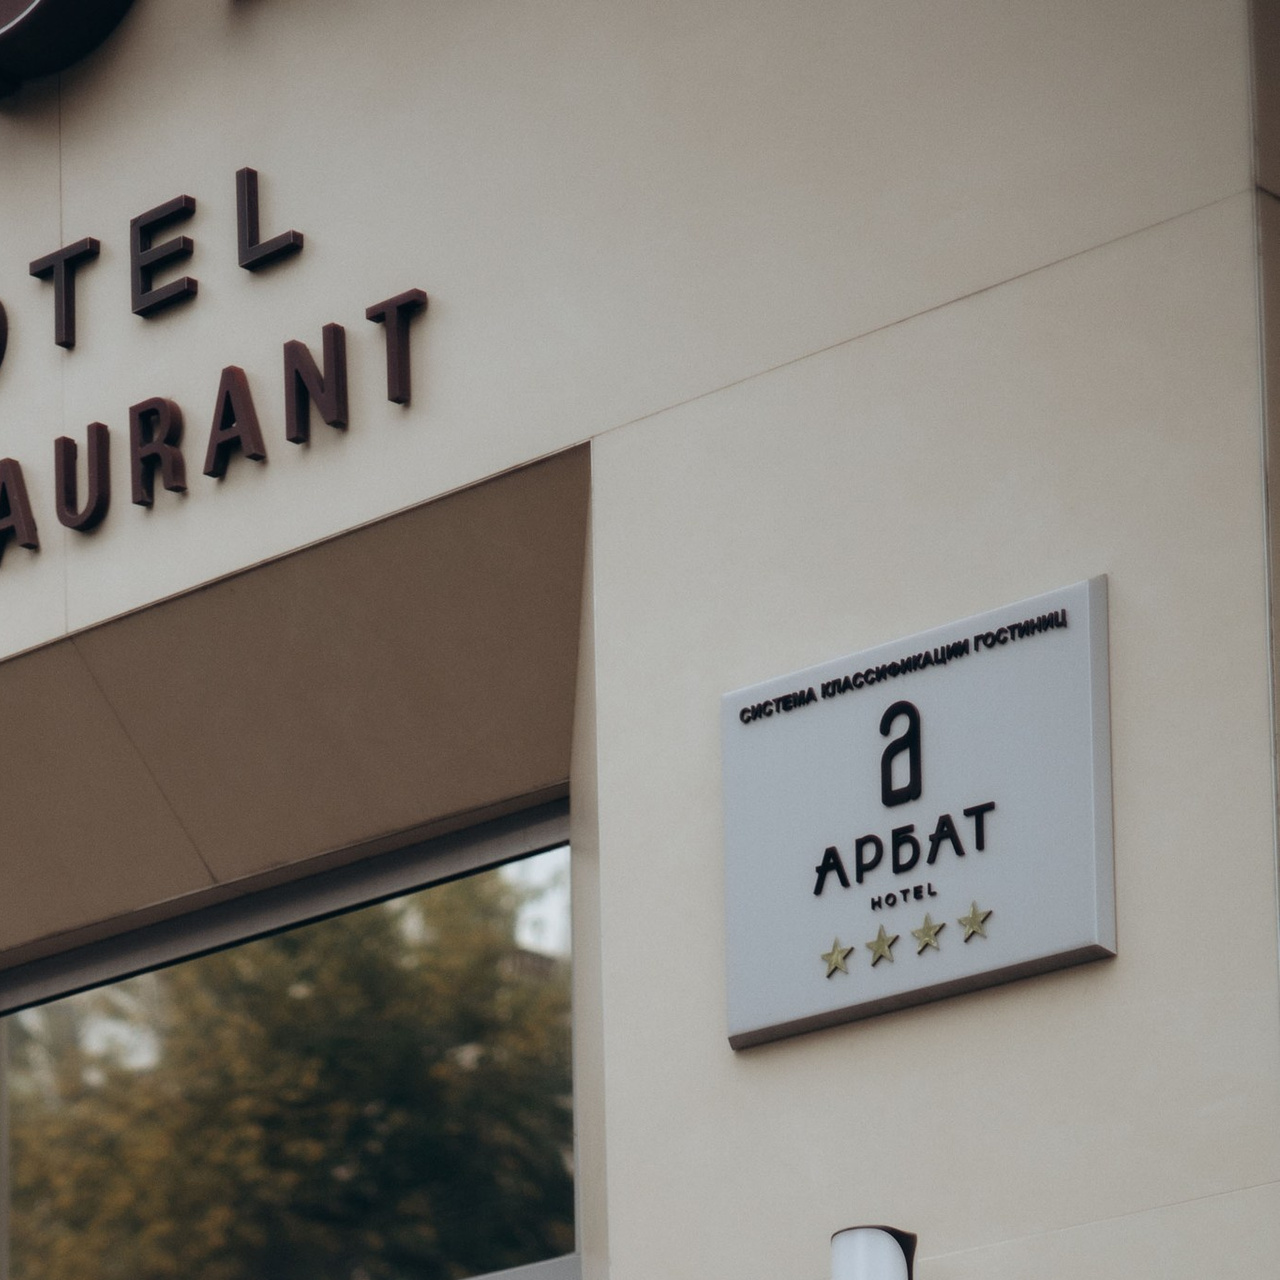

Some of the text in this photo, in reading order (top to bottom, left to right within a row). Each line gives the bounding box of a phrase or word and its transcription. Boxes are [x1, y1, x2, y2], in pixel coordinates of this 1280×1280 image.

[739, 608, 1068, 724] СИСТЕМА КЛАССИФИКАЦИИ ГОСТИНИЦ
[813, 801, 996, 896] АРБАТ
[870, 882, 938, 911] HOTEL
